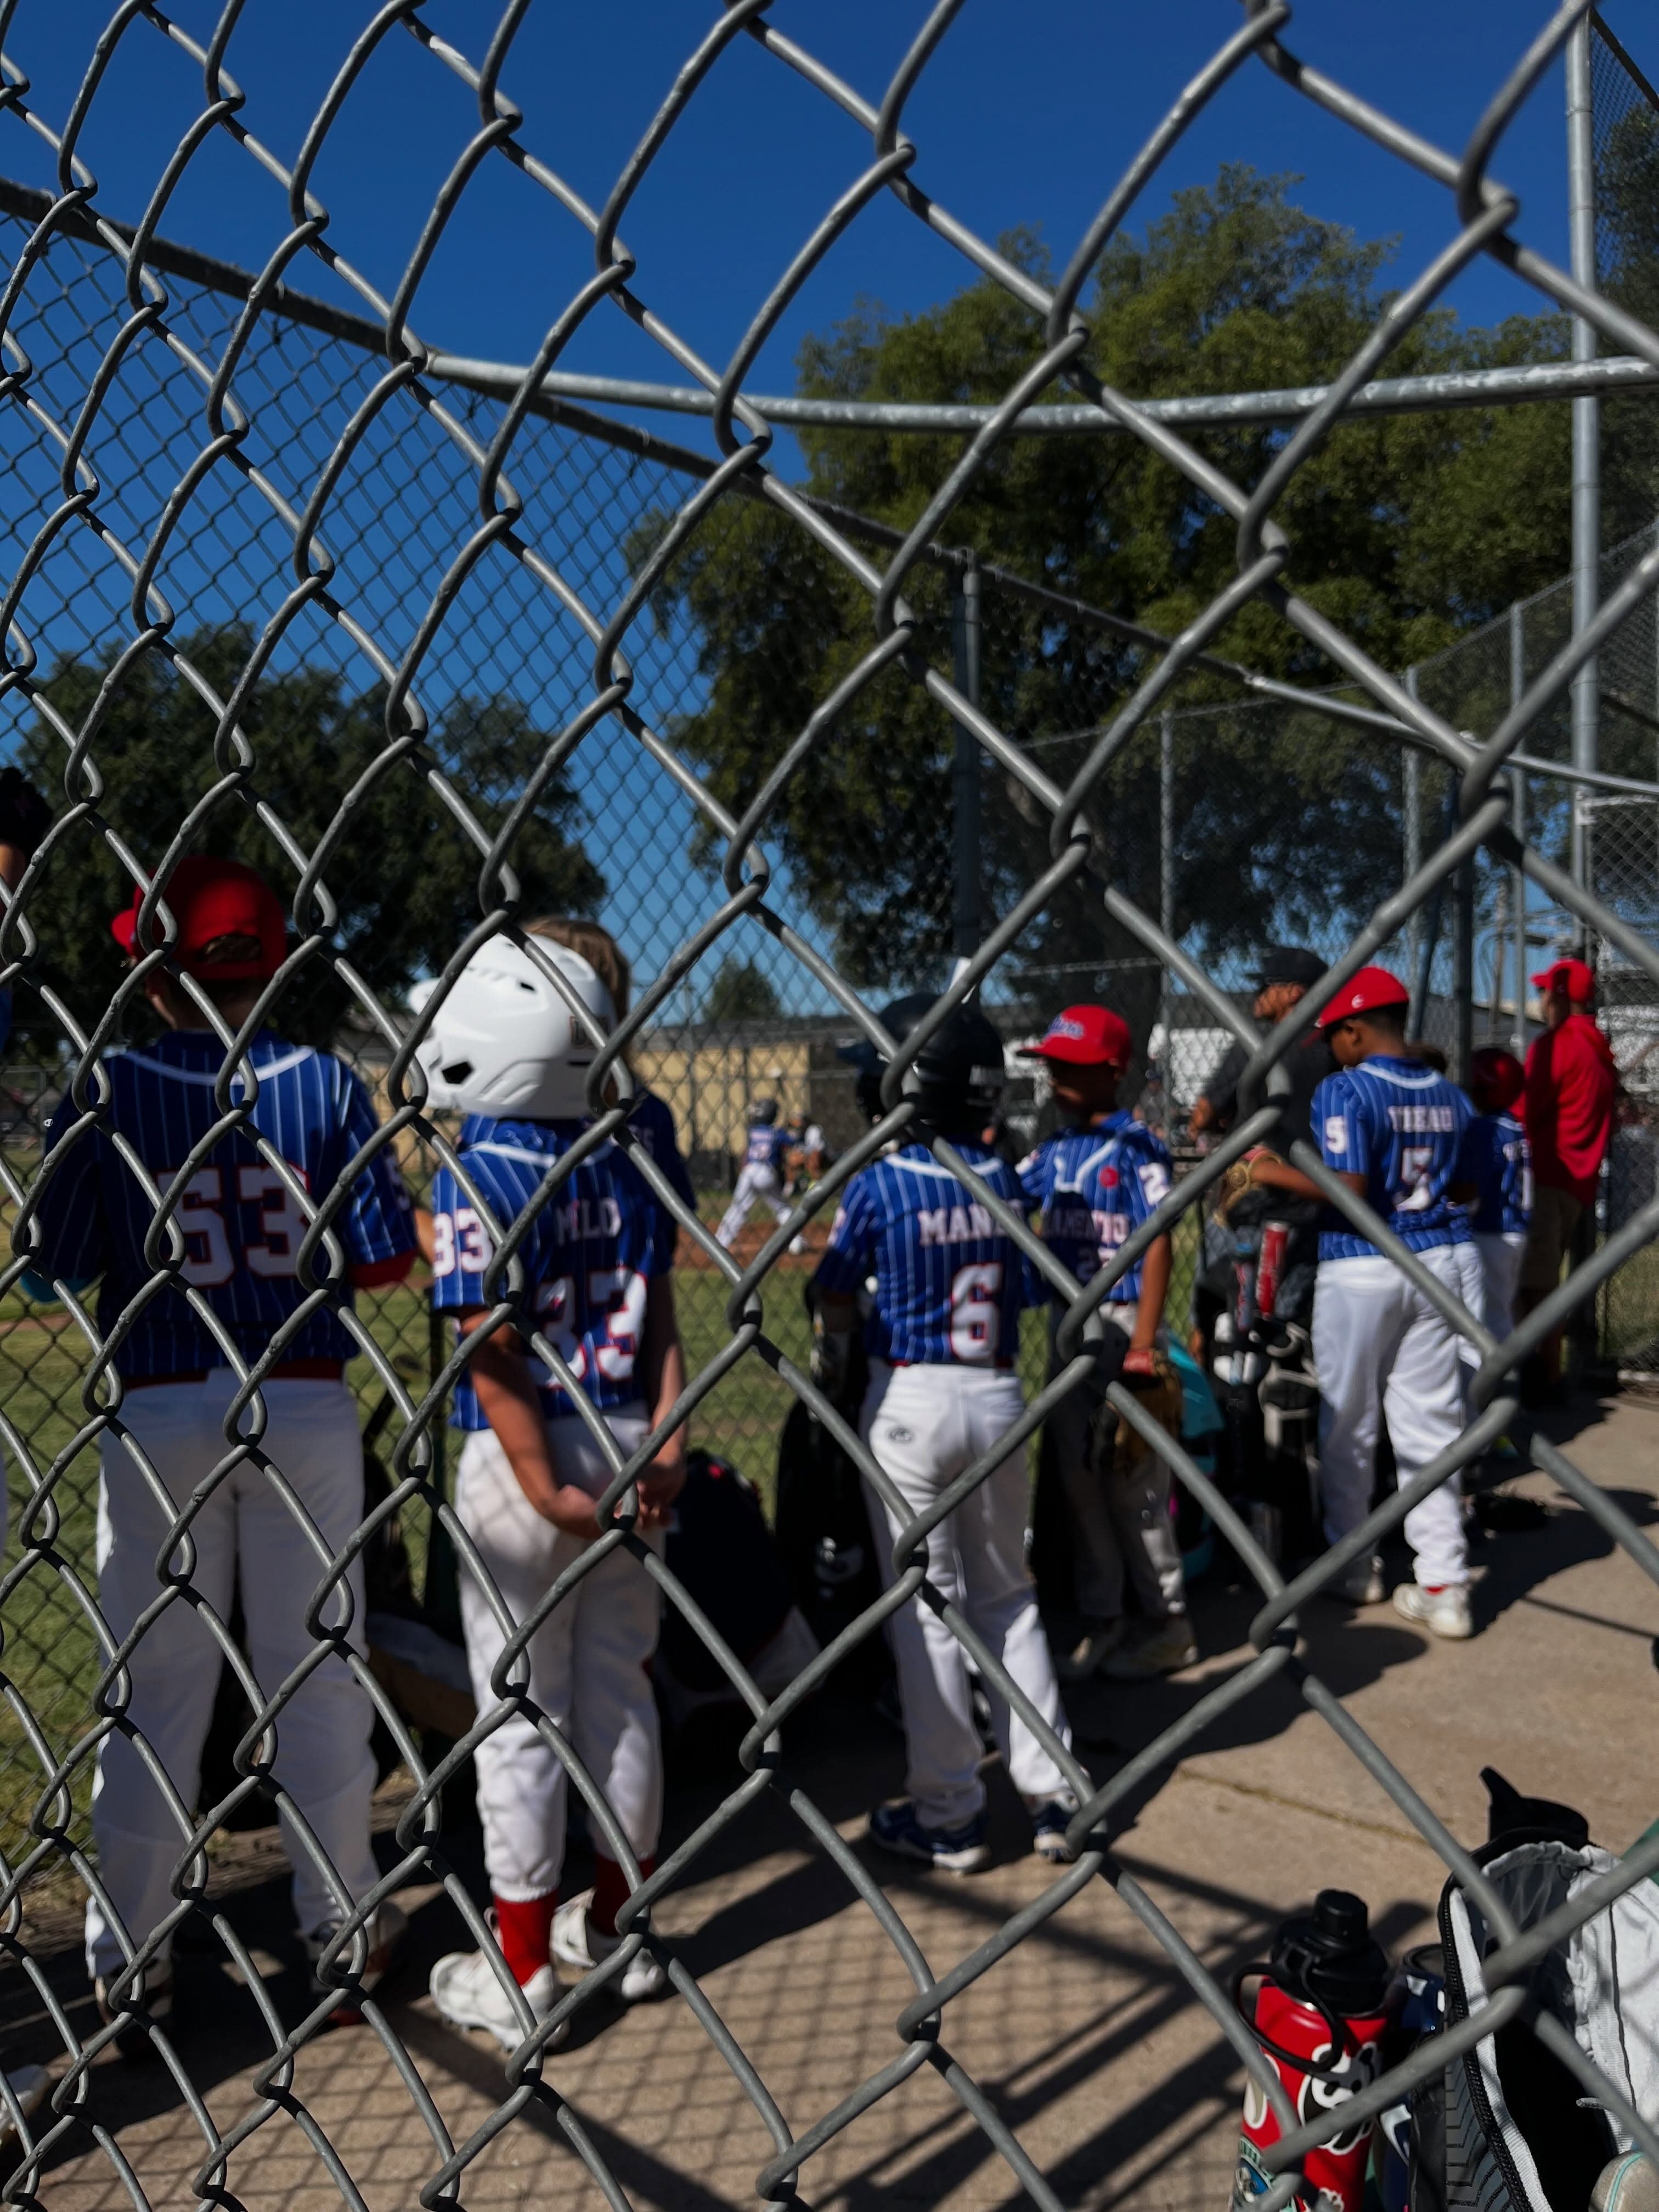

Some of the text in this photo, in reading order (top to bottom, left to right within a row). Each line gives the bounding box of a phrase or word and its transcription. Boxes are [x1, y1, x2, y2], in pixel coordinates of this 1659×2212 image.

[1325, 1115, 1348, 1154] 5
[1391, 1147, 1433, 1211] 5
[153, 1162, 312, 1288] 53
[917, 1198, 1024, 1246] MAN
[950, 1261, 1004, 1361] 6
